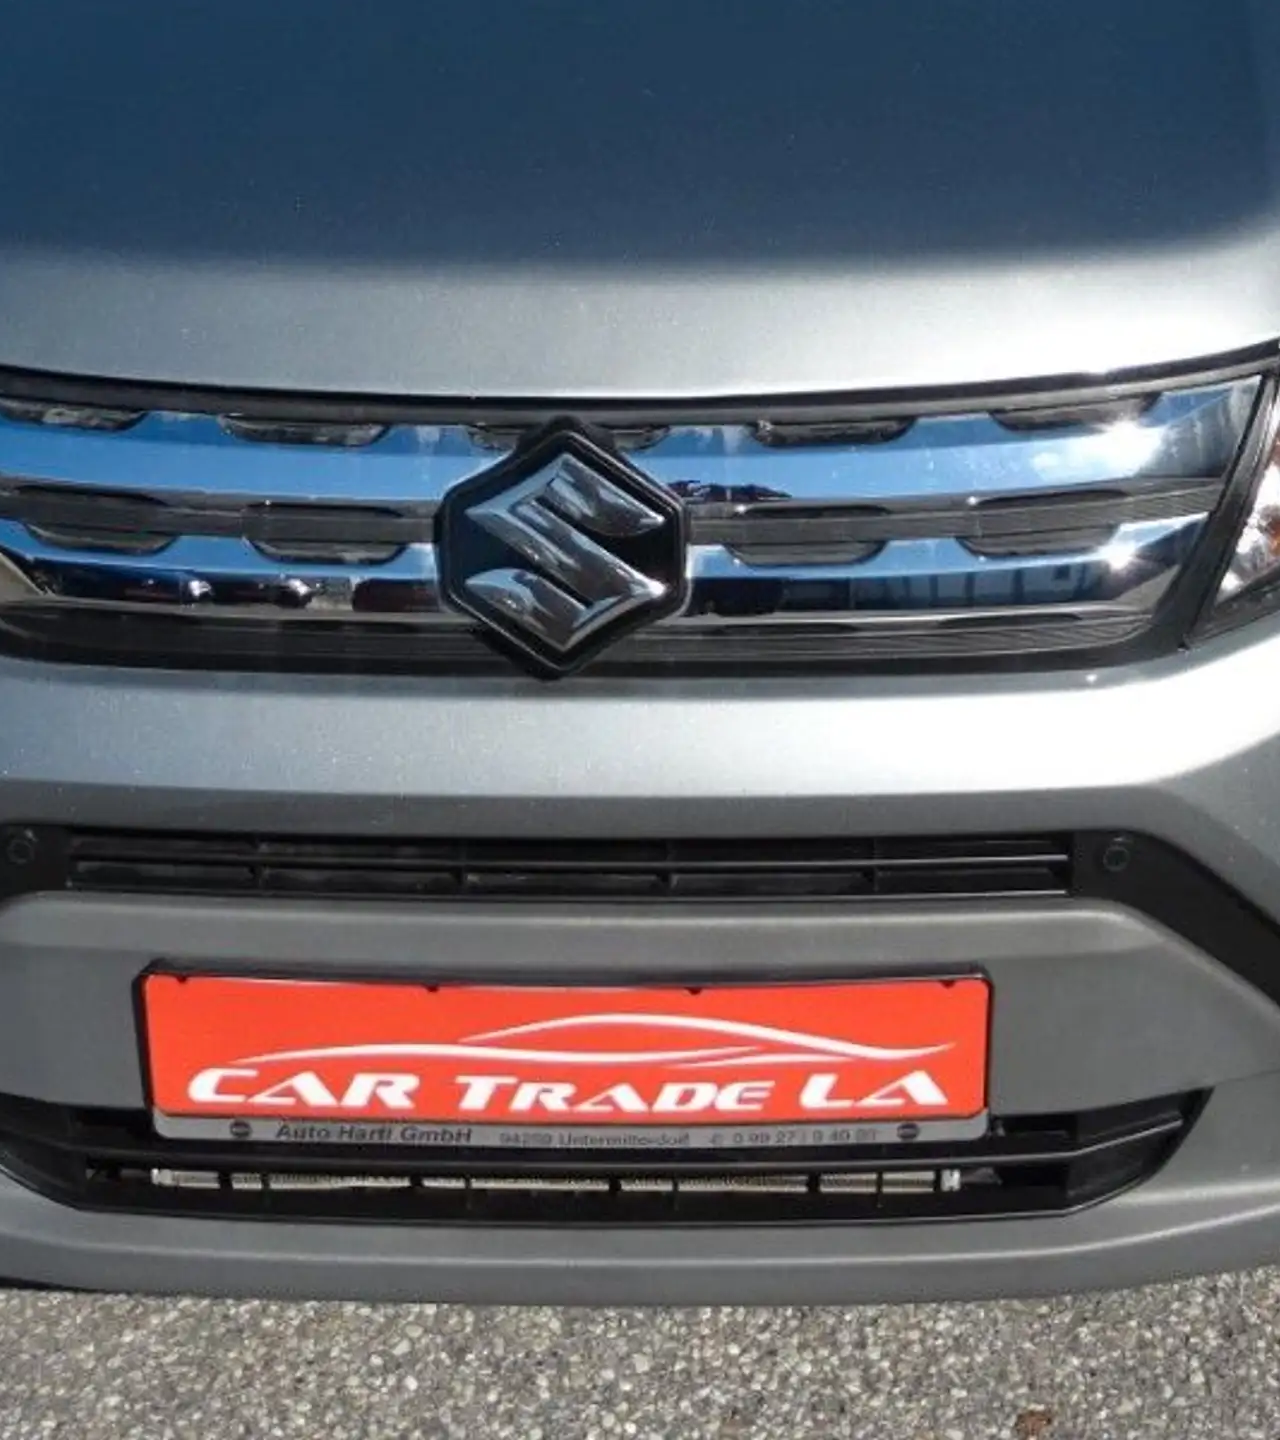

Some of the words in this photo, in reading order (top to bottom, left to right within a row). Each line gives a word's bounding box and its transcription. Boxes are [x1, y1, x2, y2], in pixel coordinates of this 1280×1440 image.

[187, 1067, 421, 1110] CAR
[455, 1074, 776, 1114] TRADE
[799, 1069, 949, 1110] LA
[275, 1124, 330, 1140] Auto
[400, 1126, 473, 1144] GmbH
